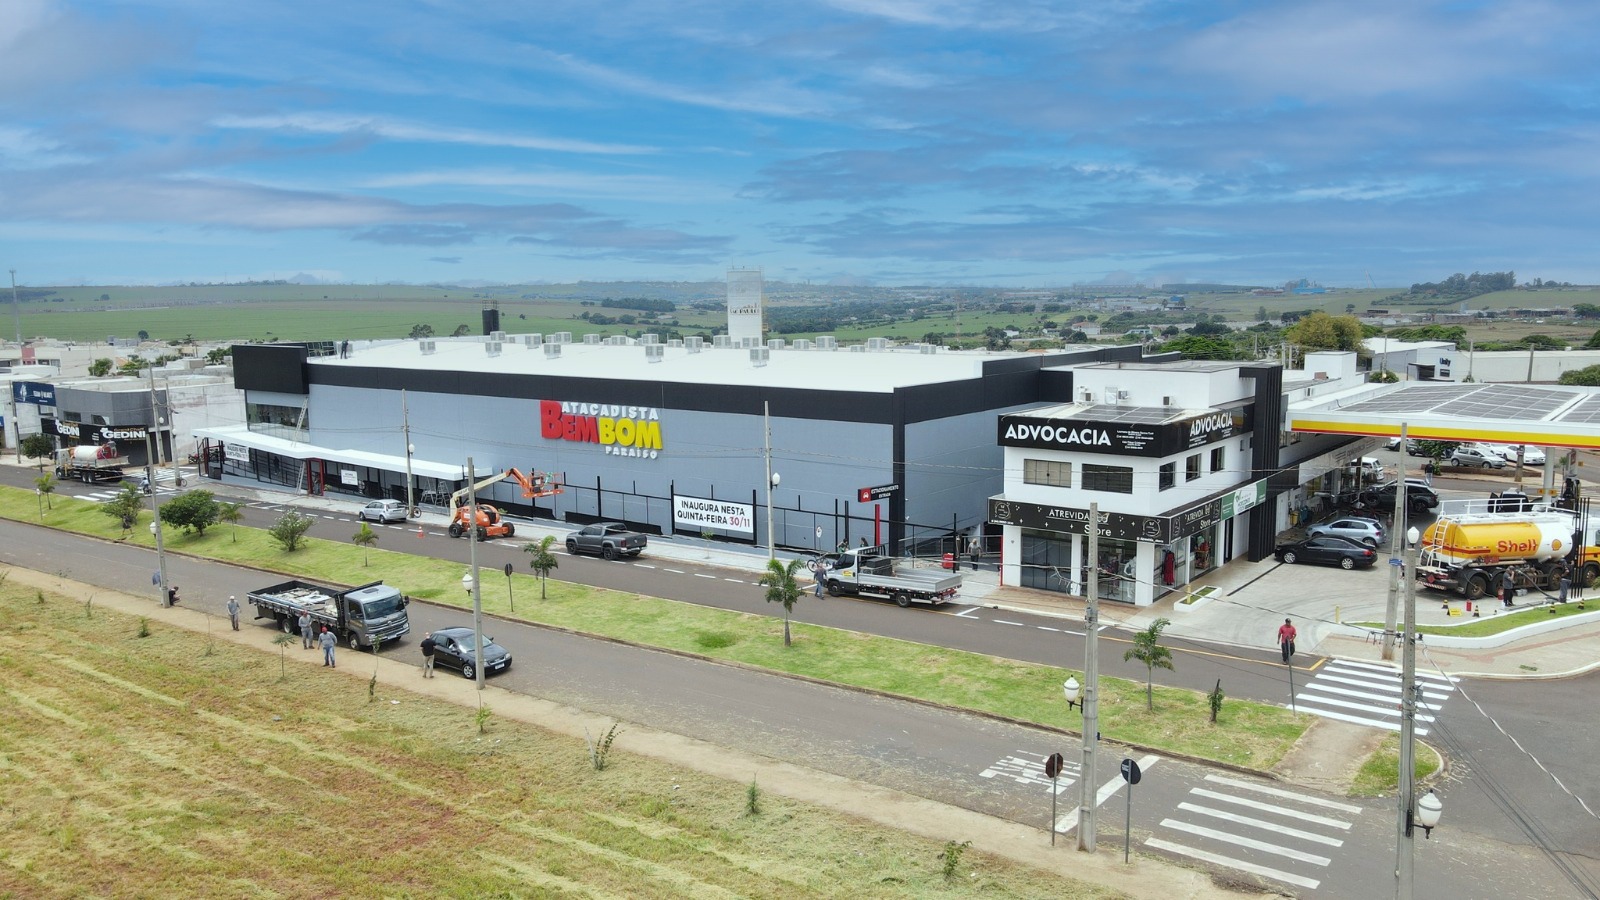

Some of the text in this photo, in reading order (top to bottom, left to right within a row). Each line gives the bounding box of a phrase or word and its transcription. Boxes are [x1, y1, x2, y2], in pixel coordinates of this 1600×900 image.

[561, 401, 660, 421] ATACADISTA
[1190, 411, 1233, 437] ADVOCACIA
[102, 429, 146, 439] GEDINI
[1004, 423, 1112, 446] ADVOCACIA
[681, 499, 745, 516] INAUGURA NESTA
[1048, 508, 1091, 521] ATREVIDA
[677, 510, 751, 528] QUINTA-FEIRA 30/11
[1084, 524, 1112, 537] Sore
[1497, 538, 1539, 553] Shell
